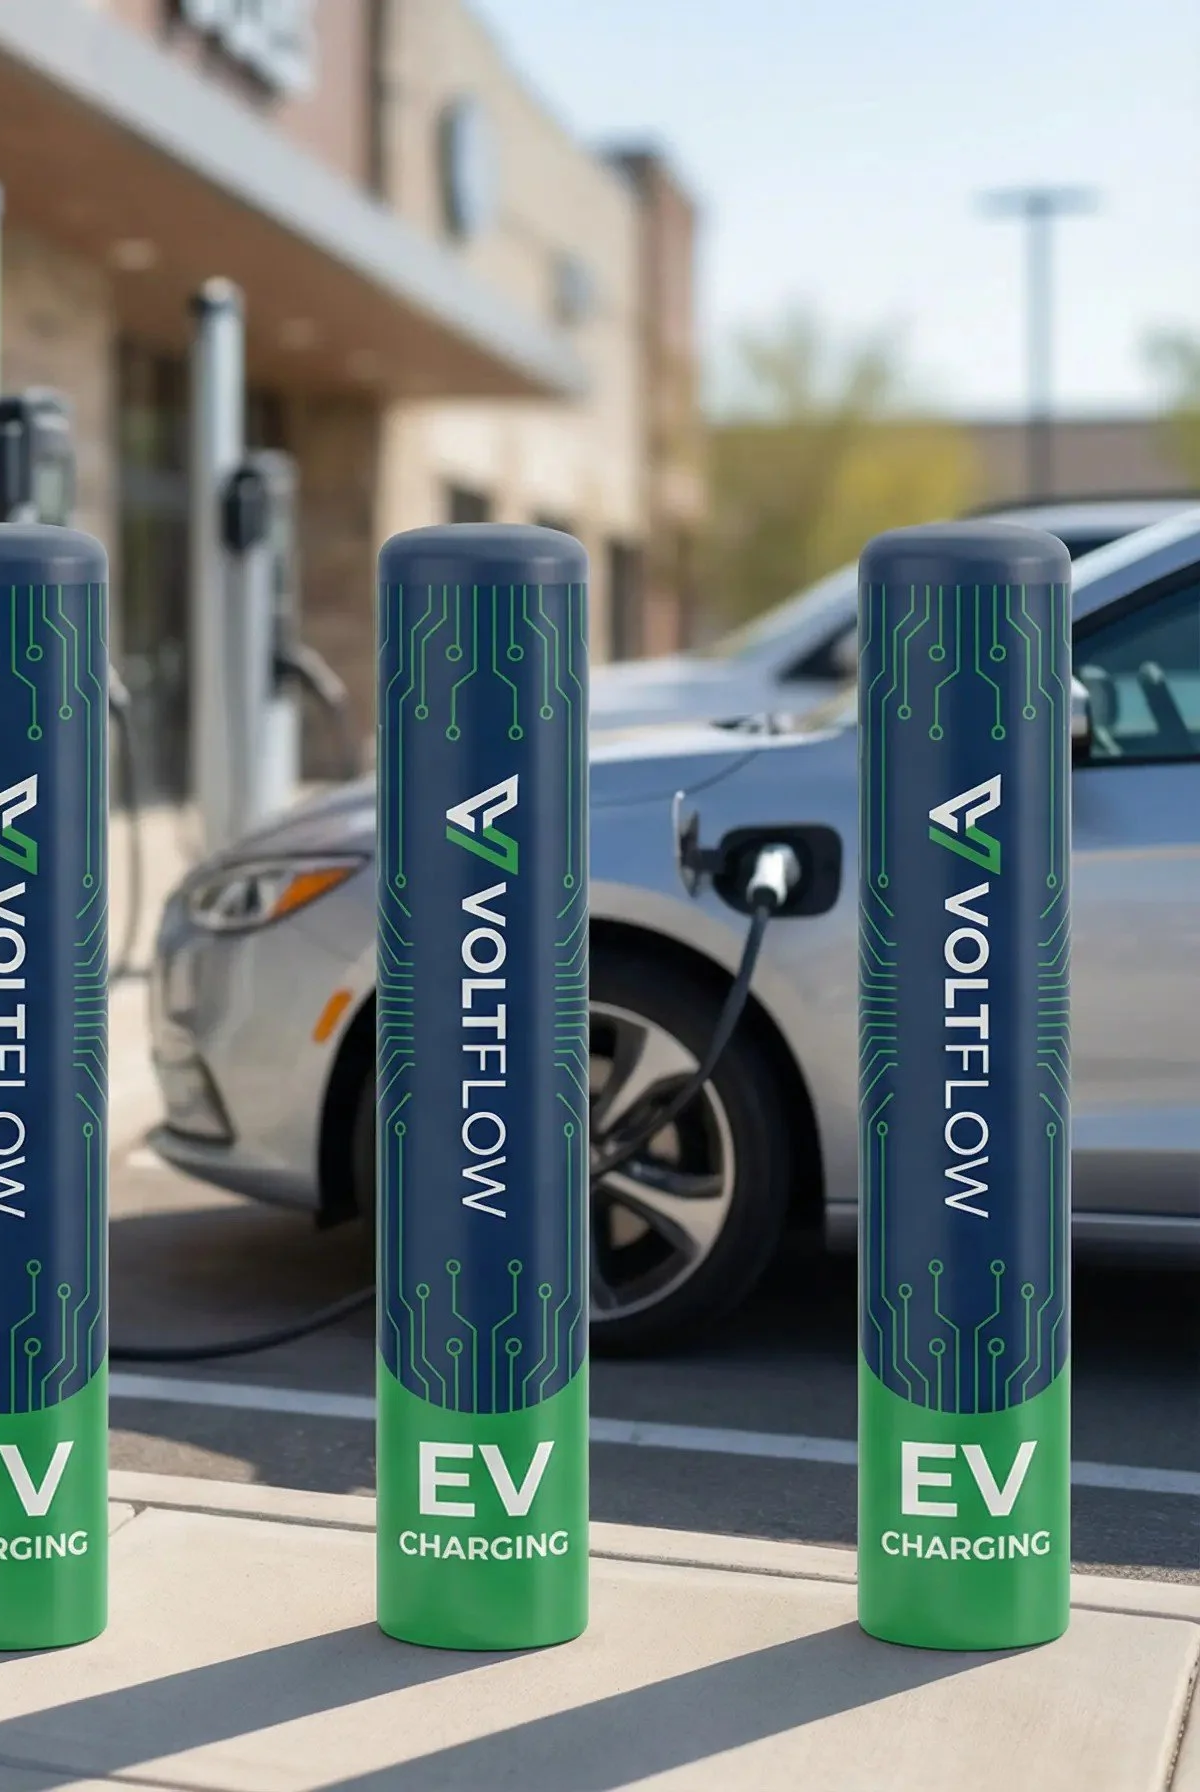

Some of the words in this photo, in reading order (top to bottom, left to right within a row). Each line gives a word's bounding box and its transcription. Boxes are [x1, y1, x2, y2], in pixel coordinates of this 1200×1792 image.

[462, 882, 506, 1218] VOLTFLOW
[945, 882, 989, 1218] VOLTFLOW
[420, 1441, 554, 1517] EV
[902, 1441, 1037, 1517] EV
[399, 1531, 568, 1560] CHARGING
[882, 1531, 1050, 1560] CHARGING
